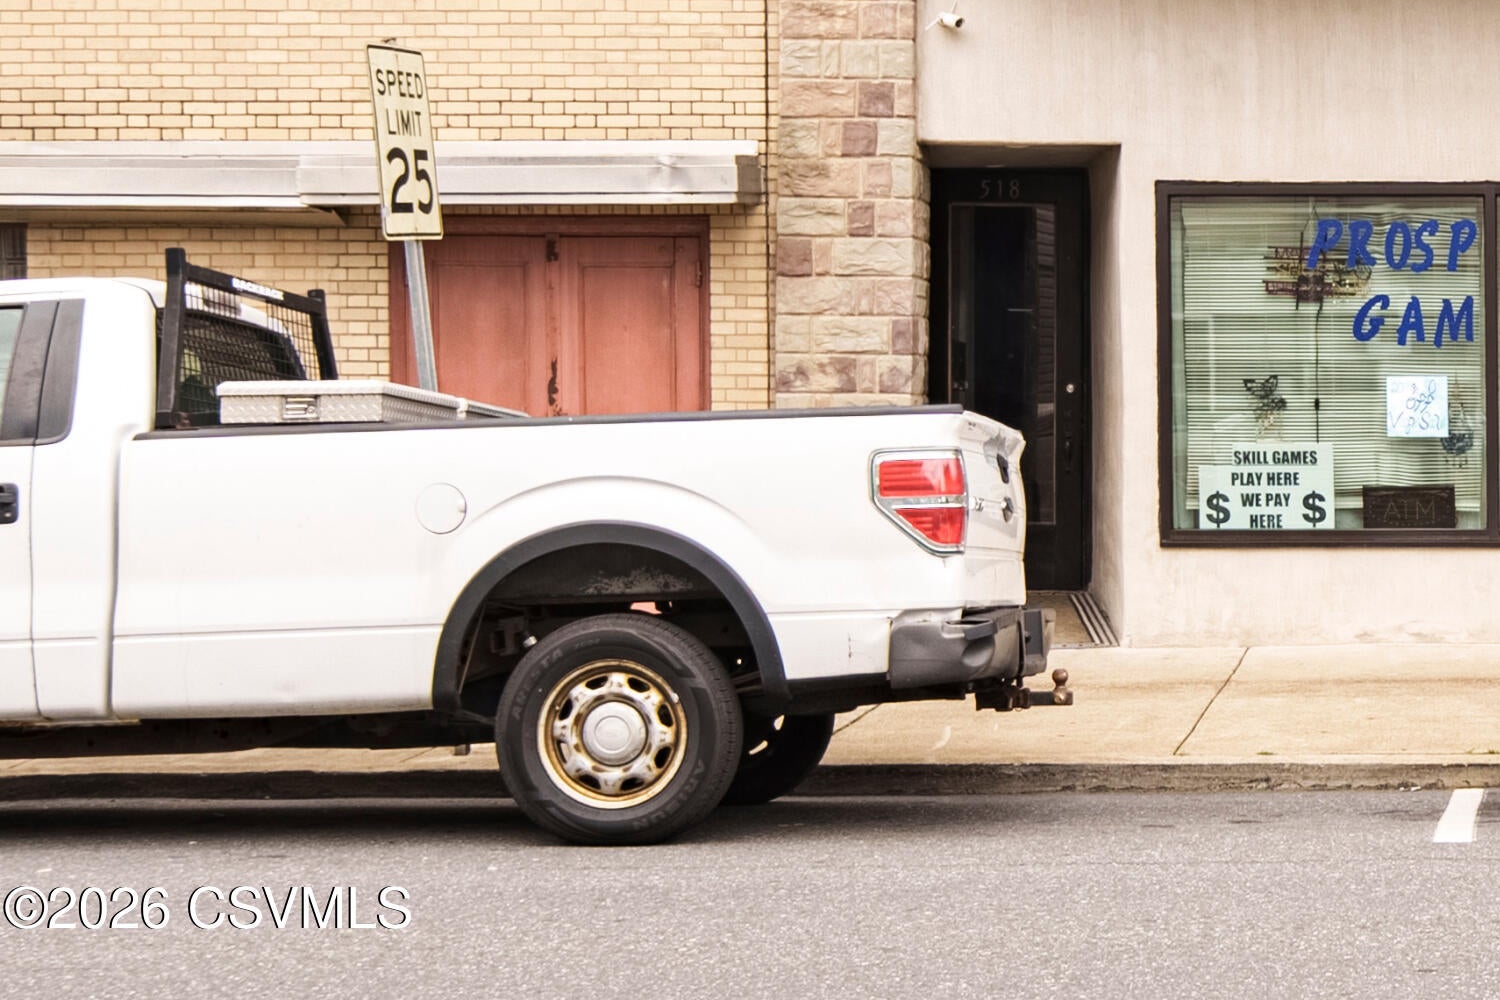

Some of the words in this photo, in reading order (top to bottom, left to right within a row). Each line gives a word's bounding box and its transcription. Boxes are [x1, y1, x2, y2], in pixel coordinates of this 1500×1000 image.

[375, 68, 423, 99] SPEED
[386, 108, 423, 137] LIMIT
[386, 147, 434, 215] 25
[979, 178, 1021, 200] 518
[1233, 450, 1269, 465] SKILL
[1272, 450, 1318, 465] GAMES
[1231, 472, 1263, 486] PLAY
[1266, 472, 1300, 486] HERE
[1241, 492, 1262, 507] WE
[1265, 492, 1291, 507] PAY
[1383, 497, 1436, 521] ATM
[1249, 514, 1283, 529] HERE
